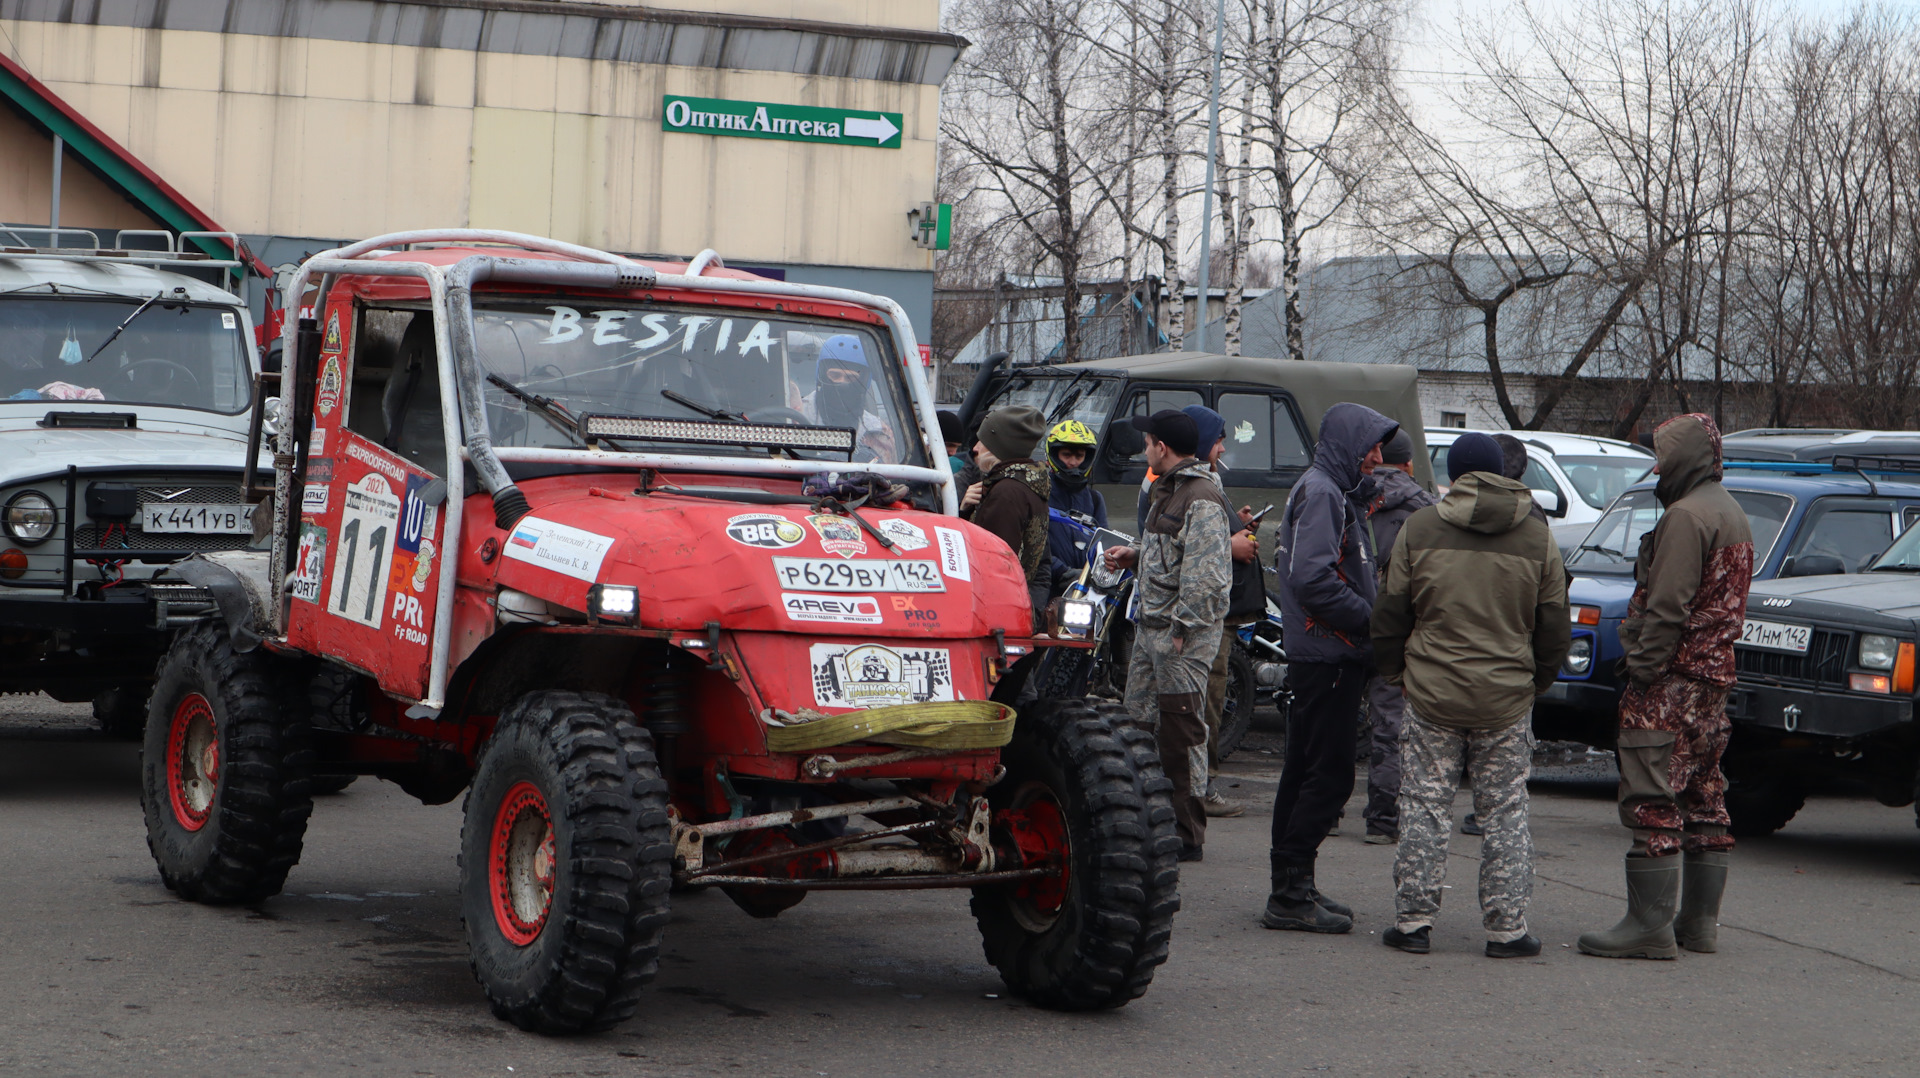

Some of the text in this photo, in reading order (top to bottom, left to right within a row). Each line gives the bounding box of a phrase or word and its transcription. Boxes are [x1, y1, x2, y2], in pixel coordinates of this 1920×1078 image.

[666, 100, 840, 138] ОптикАптека
[539, 306, 782, 363] BESTIA
[366, 477, 385, 494] 2021
[152, 507, 236, 529] К441УВ
[403, 488, 423, 543] 10
[741, 523, 776, 543] BG
[942, 532, 957, 572] БОЧКАРИ
[338, 518, 387, 622] 11
[785, 562, 934, 588] Р629ВУ 142
[293, 579, 318, 597] PORT
[906, 581, 927, 589] RUS
[890, 595, 918, 611] EX
[1762, 597, 1793, 608] Jeep
[904, 609, 938, 621] PRO
[405, 629, 428, 646] ROAD
[1739, 623, 1808, 646] 21НМ 142
[846, 683, 910, 698] ТАНКОФФ
